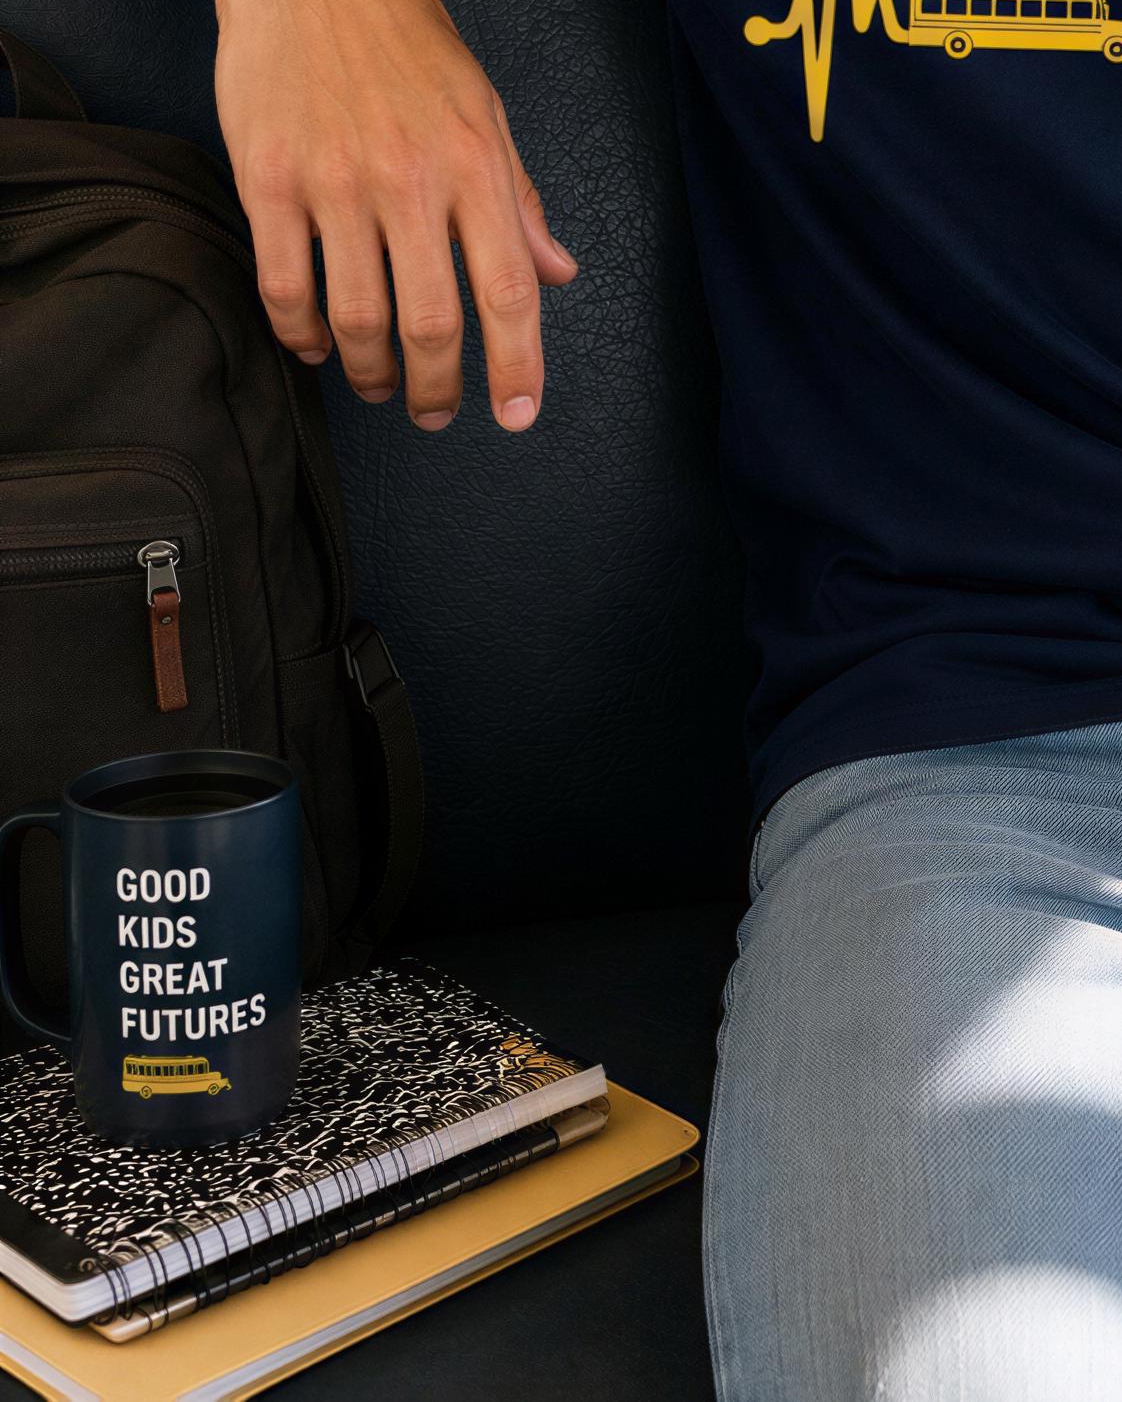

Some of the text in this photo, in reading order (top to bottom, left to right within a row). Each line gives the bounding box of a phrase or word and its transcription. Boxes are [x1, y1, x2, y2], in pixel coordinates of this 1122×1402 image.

[116, 867, 211, 903] GOOD
[117, 914, 197, 949] KIDS
[119, 958, 228, 996] GREAT
[121, 993, 266, 1041] FUTURES
